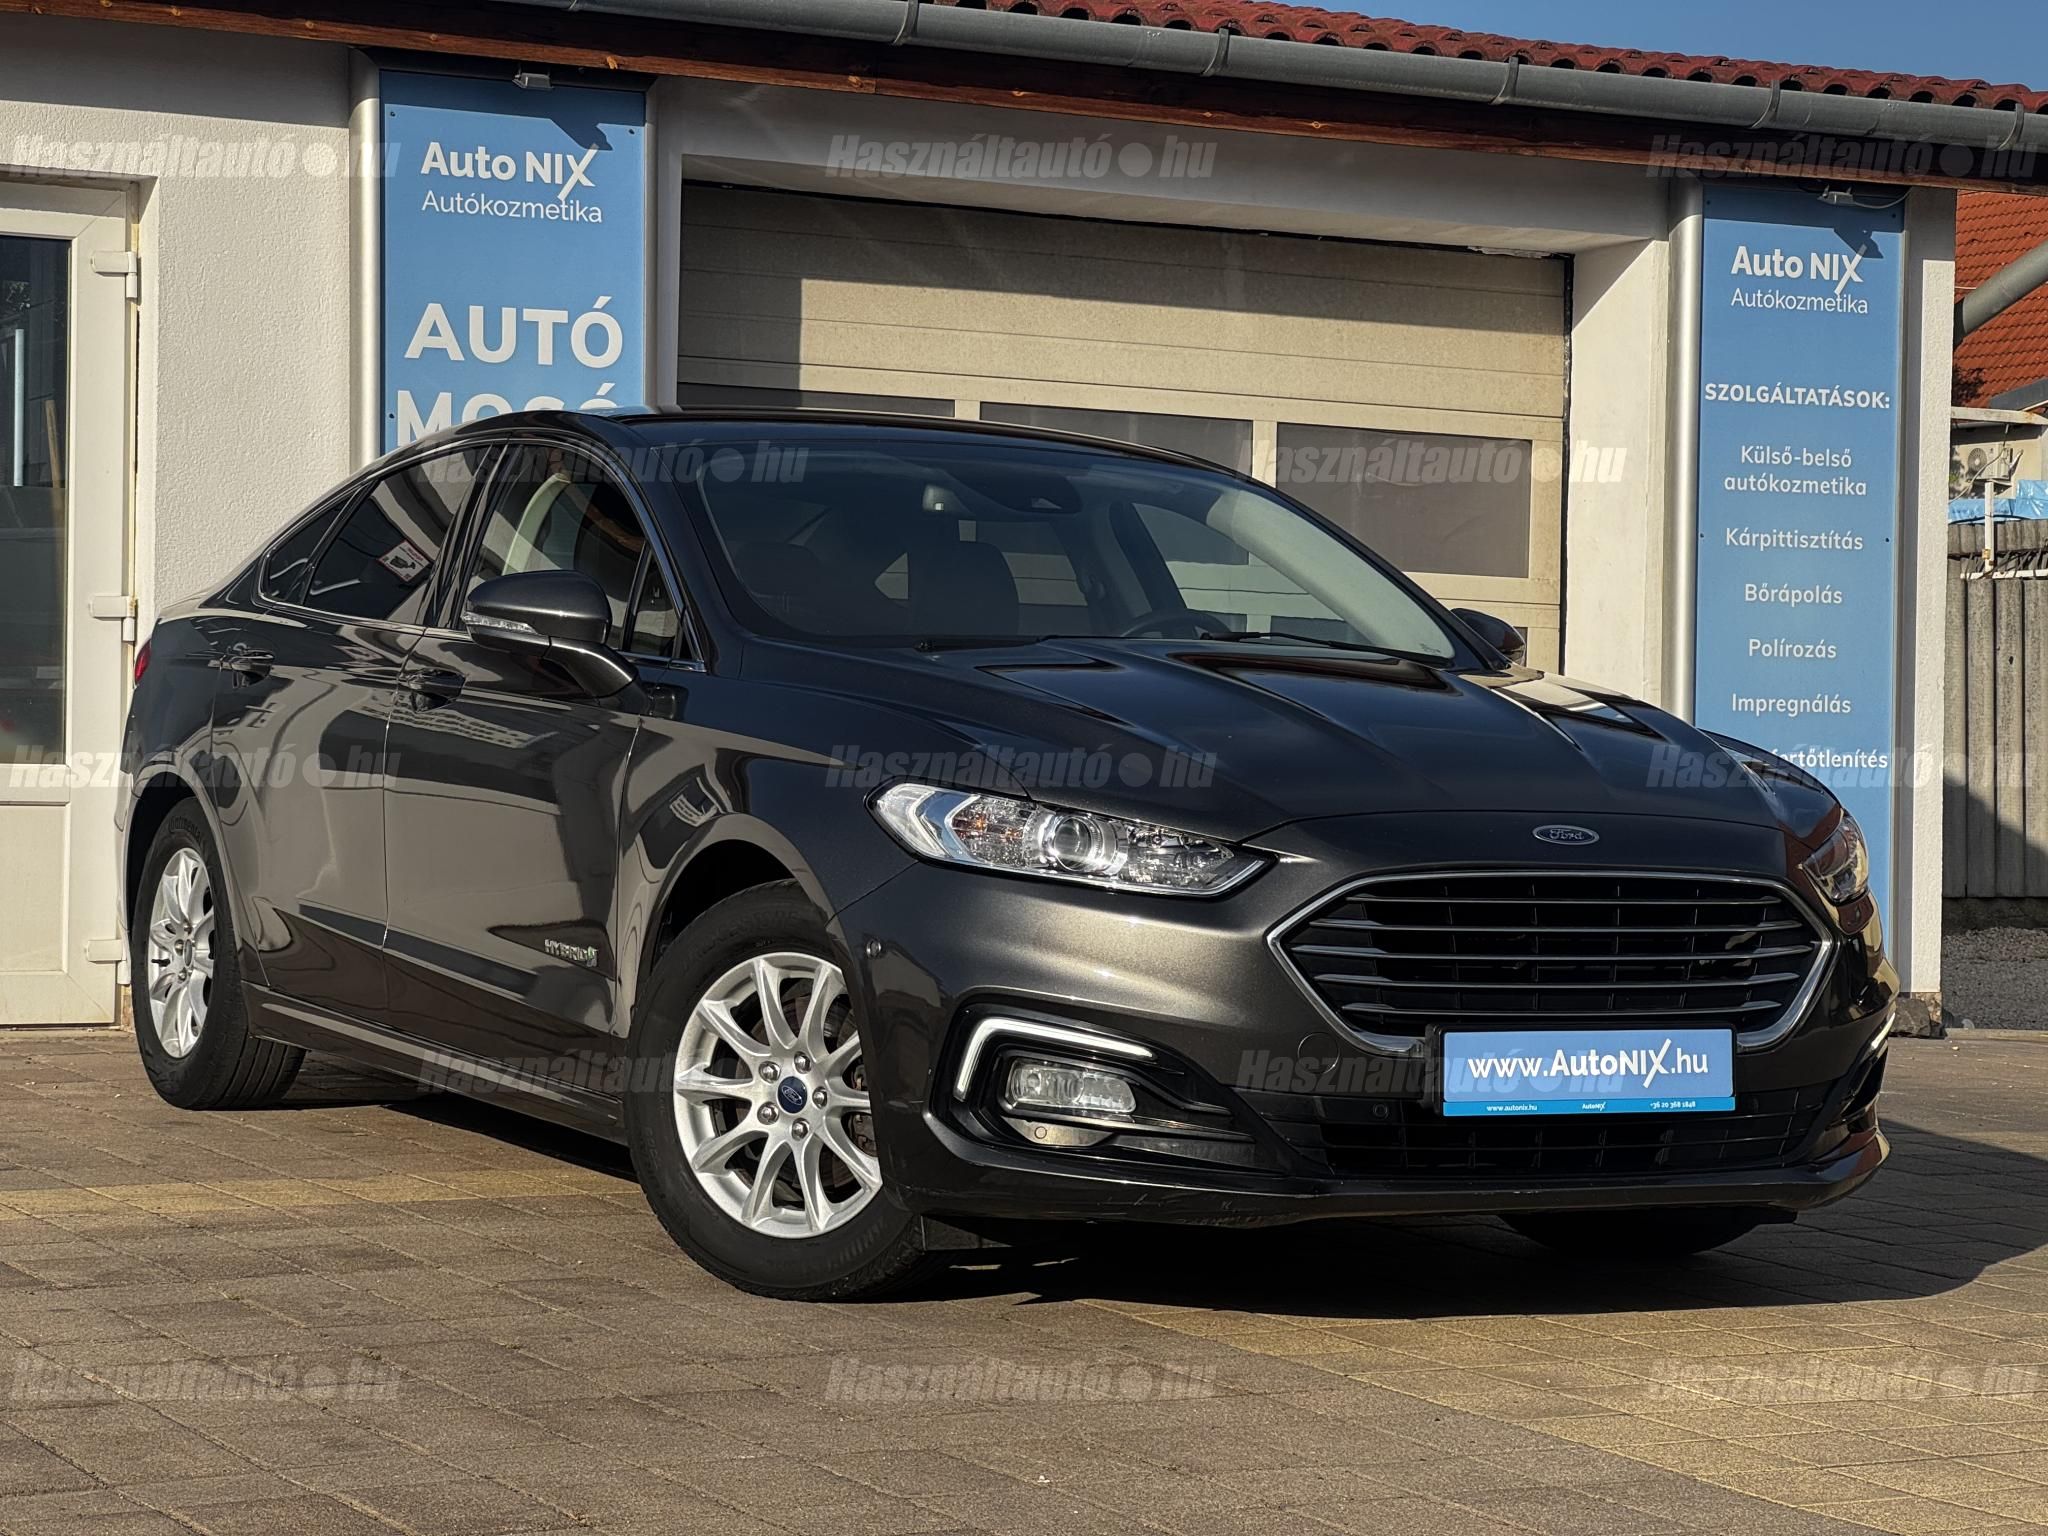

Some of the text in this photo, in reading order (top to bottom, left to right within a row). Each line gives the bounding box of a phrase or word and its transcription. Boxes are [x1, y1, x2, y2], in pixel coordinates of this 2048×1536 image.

[420, 141, 600, 201] Auto NIX
[421, 190, 603, 224] Autókozmetika
[1730, 244, 1868, 295] Auto NIX
[1730, 287, 1869, 314] Autókozmetika
[404, 295, 624, 369] AUTÓ
[1704, 382, 1891, 409] SZOLGÁLTATÁSOK:
[1740, 445, 1853, 468] Külső-belső
[1723, 474, 1867, 496] autókozmetika
[1725, 526, 1864, 550] Kárpittisztítás
[1744, 583, 1843, 607] Bőrápolás
[1748, 638, 1837, 659] Polírozás
[1731, 693, 1851, 717] Impregnálás
[1467, 1038, 1709, 1089] www.AutoNIX.hu
[1486, 1103, 1538, 1112] www.autonix.hu
[1581, 1101, 1606, 1111] AutoNIX
